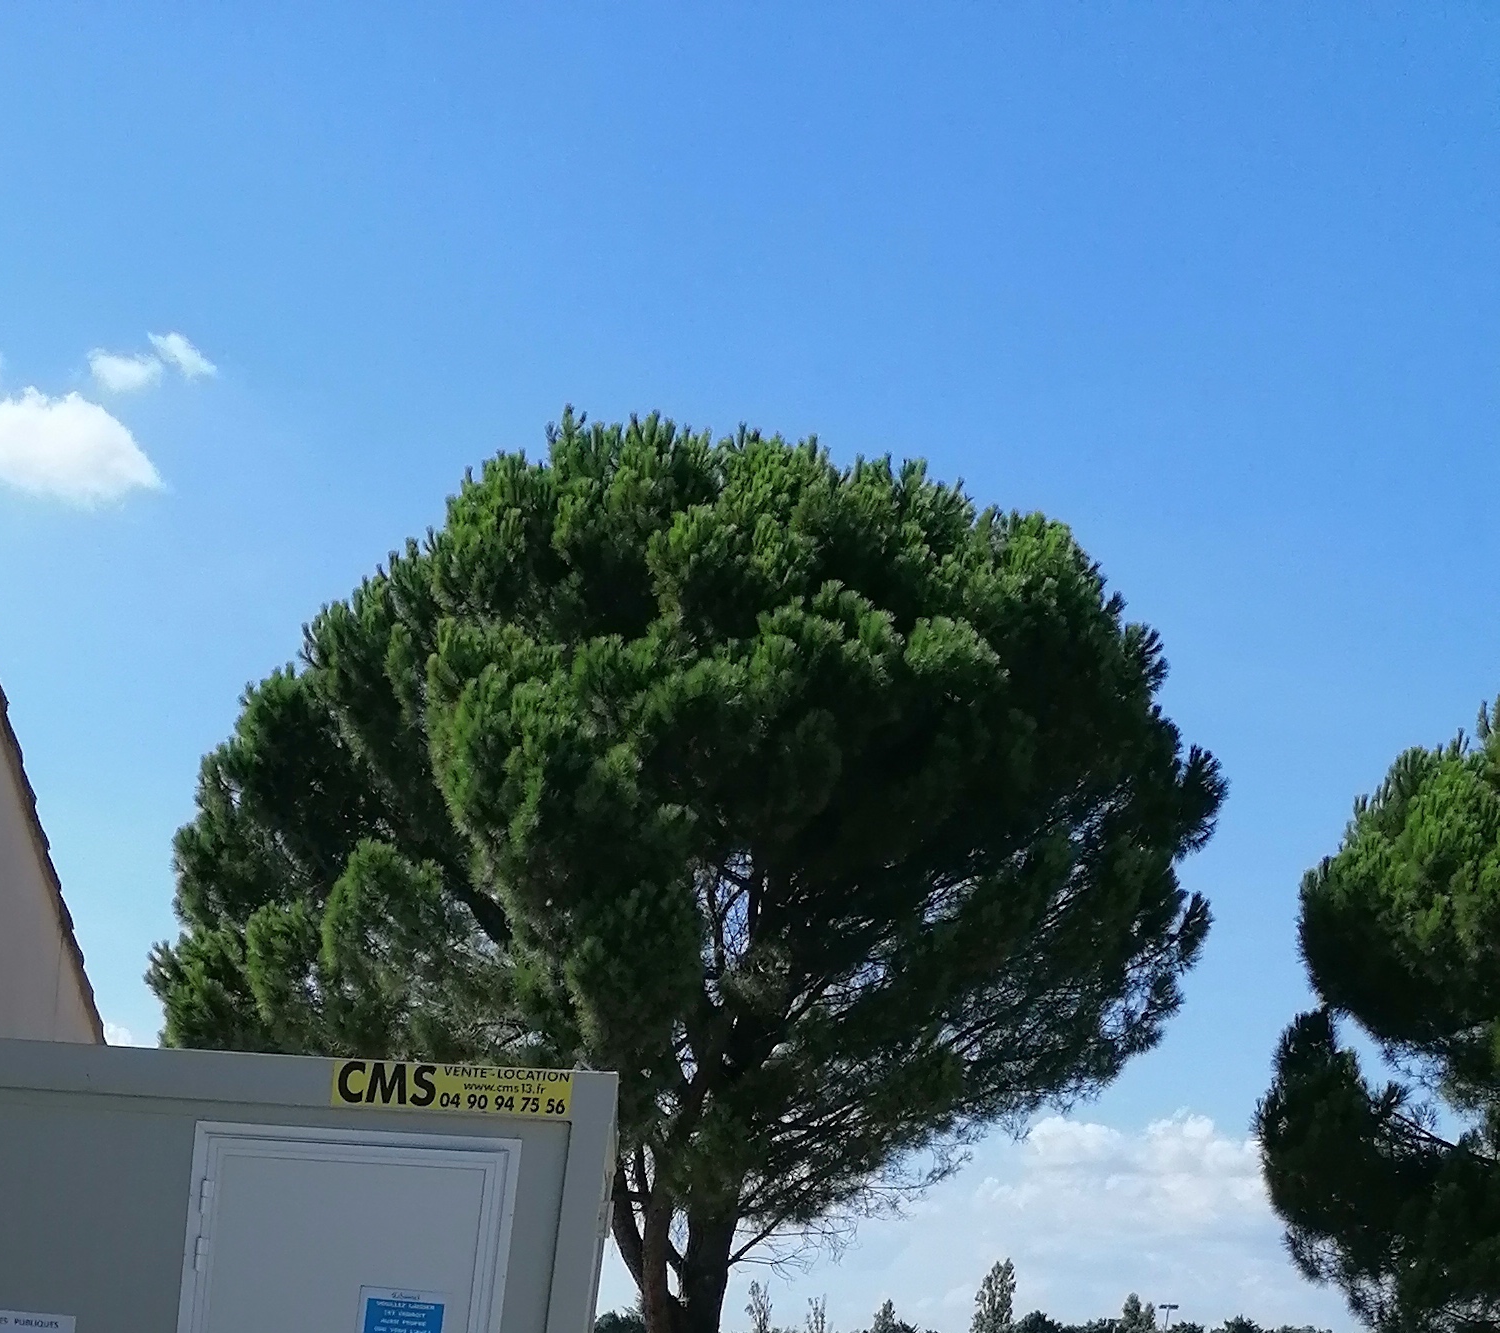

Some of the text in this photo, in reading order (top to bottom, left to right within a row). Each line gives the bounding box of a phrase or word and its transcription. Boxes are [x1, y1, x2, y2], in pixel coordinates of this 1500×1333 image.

[338, 1061, 437, 1107] CMS
[463, 1082, 547, 1095] www.cms13.fr
[439, 1093, 566, 1115] 04 90 94 75 56
[14, 1317, 59, 1329] PUBLIQUES
